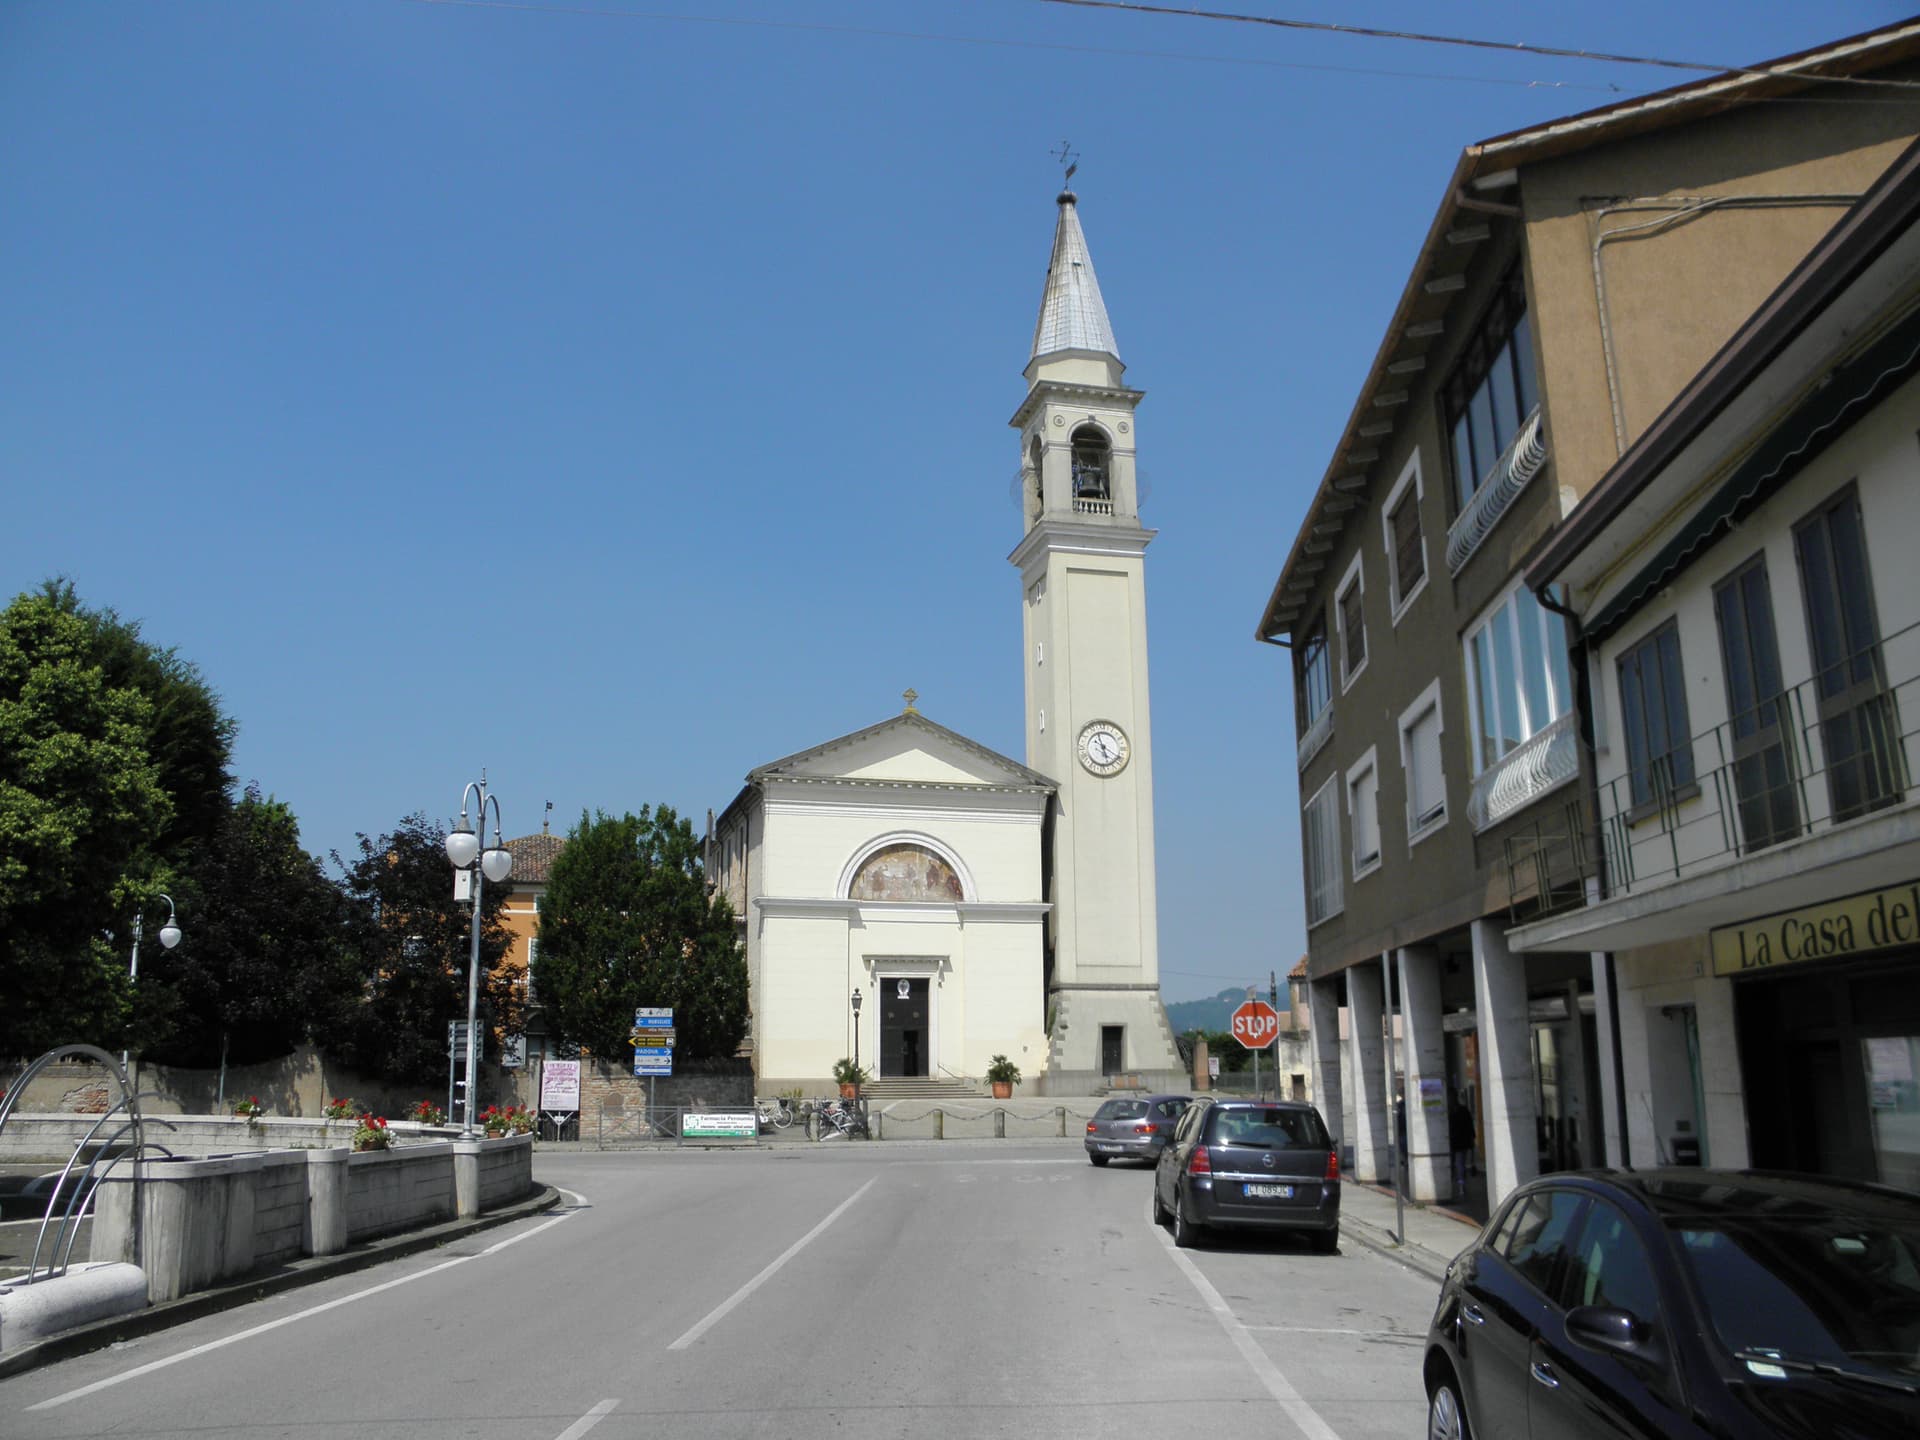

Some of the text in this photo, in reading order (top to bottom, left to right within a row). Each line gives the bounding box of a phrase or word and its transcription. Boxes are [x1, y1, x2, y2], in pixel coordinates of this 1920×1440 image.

[1738, 931, 1771, 969] La
[1781, 913, 1856, 961] Casa
[1235, 1015, 1276, 1034] STOP
